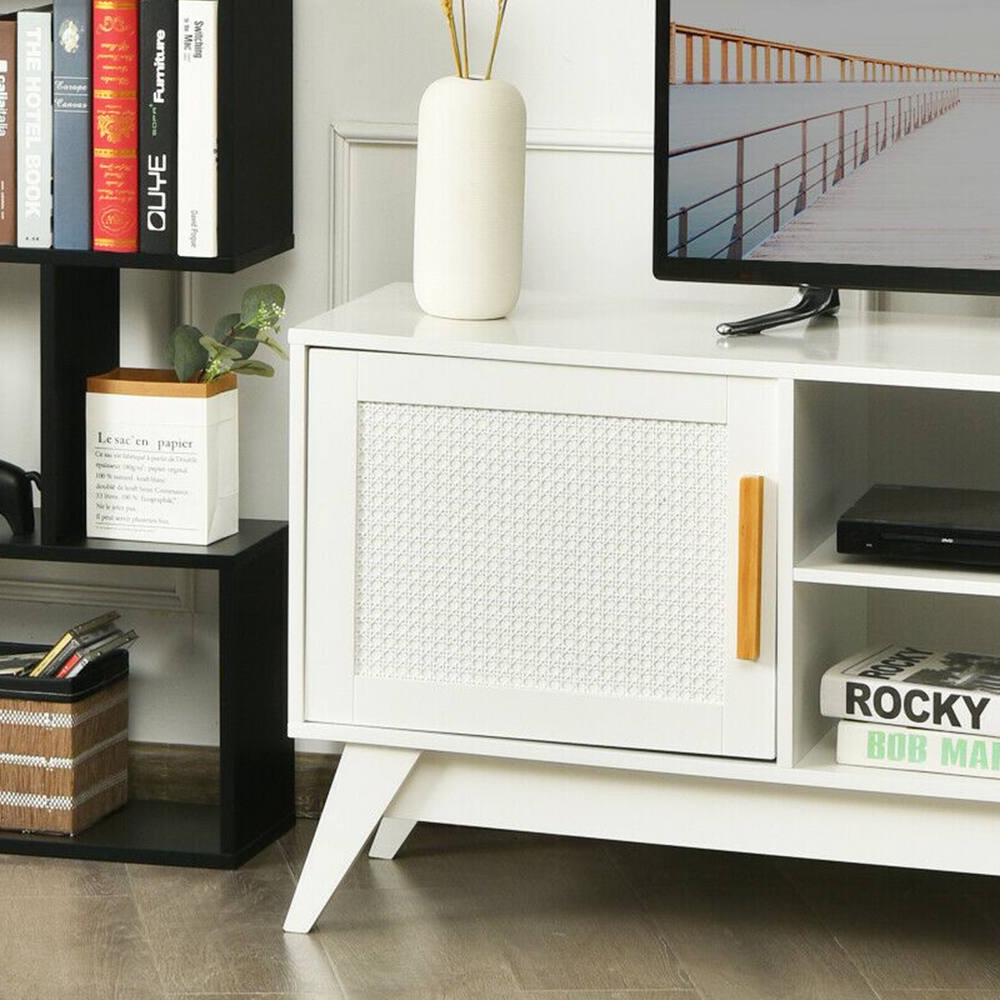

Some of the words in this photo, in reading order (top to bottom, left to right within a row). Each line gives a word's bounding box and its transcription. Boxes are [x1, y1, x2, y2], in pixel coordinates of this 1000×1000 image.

[25, 27, 42, 71] THE
[183, 34, 193, 50] Mac
[193, 20, 205, 59] Switching
[153, 29, 166, 104] Furniture
[24, 76, 42, 148] HOTEL
[24, 154, 42, 219] BOOK
[98, 432, 113, 444] Le
[136, 438, 149, 446] en
[157, 439, 193, 451] papier
[859, 647, 934, 680] ROCKY
[846, 681, 991, 730] ROCKY
[867, 730, 928, 764] BOB
